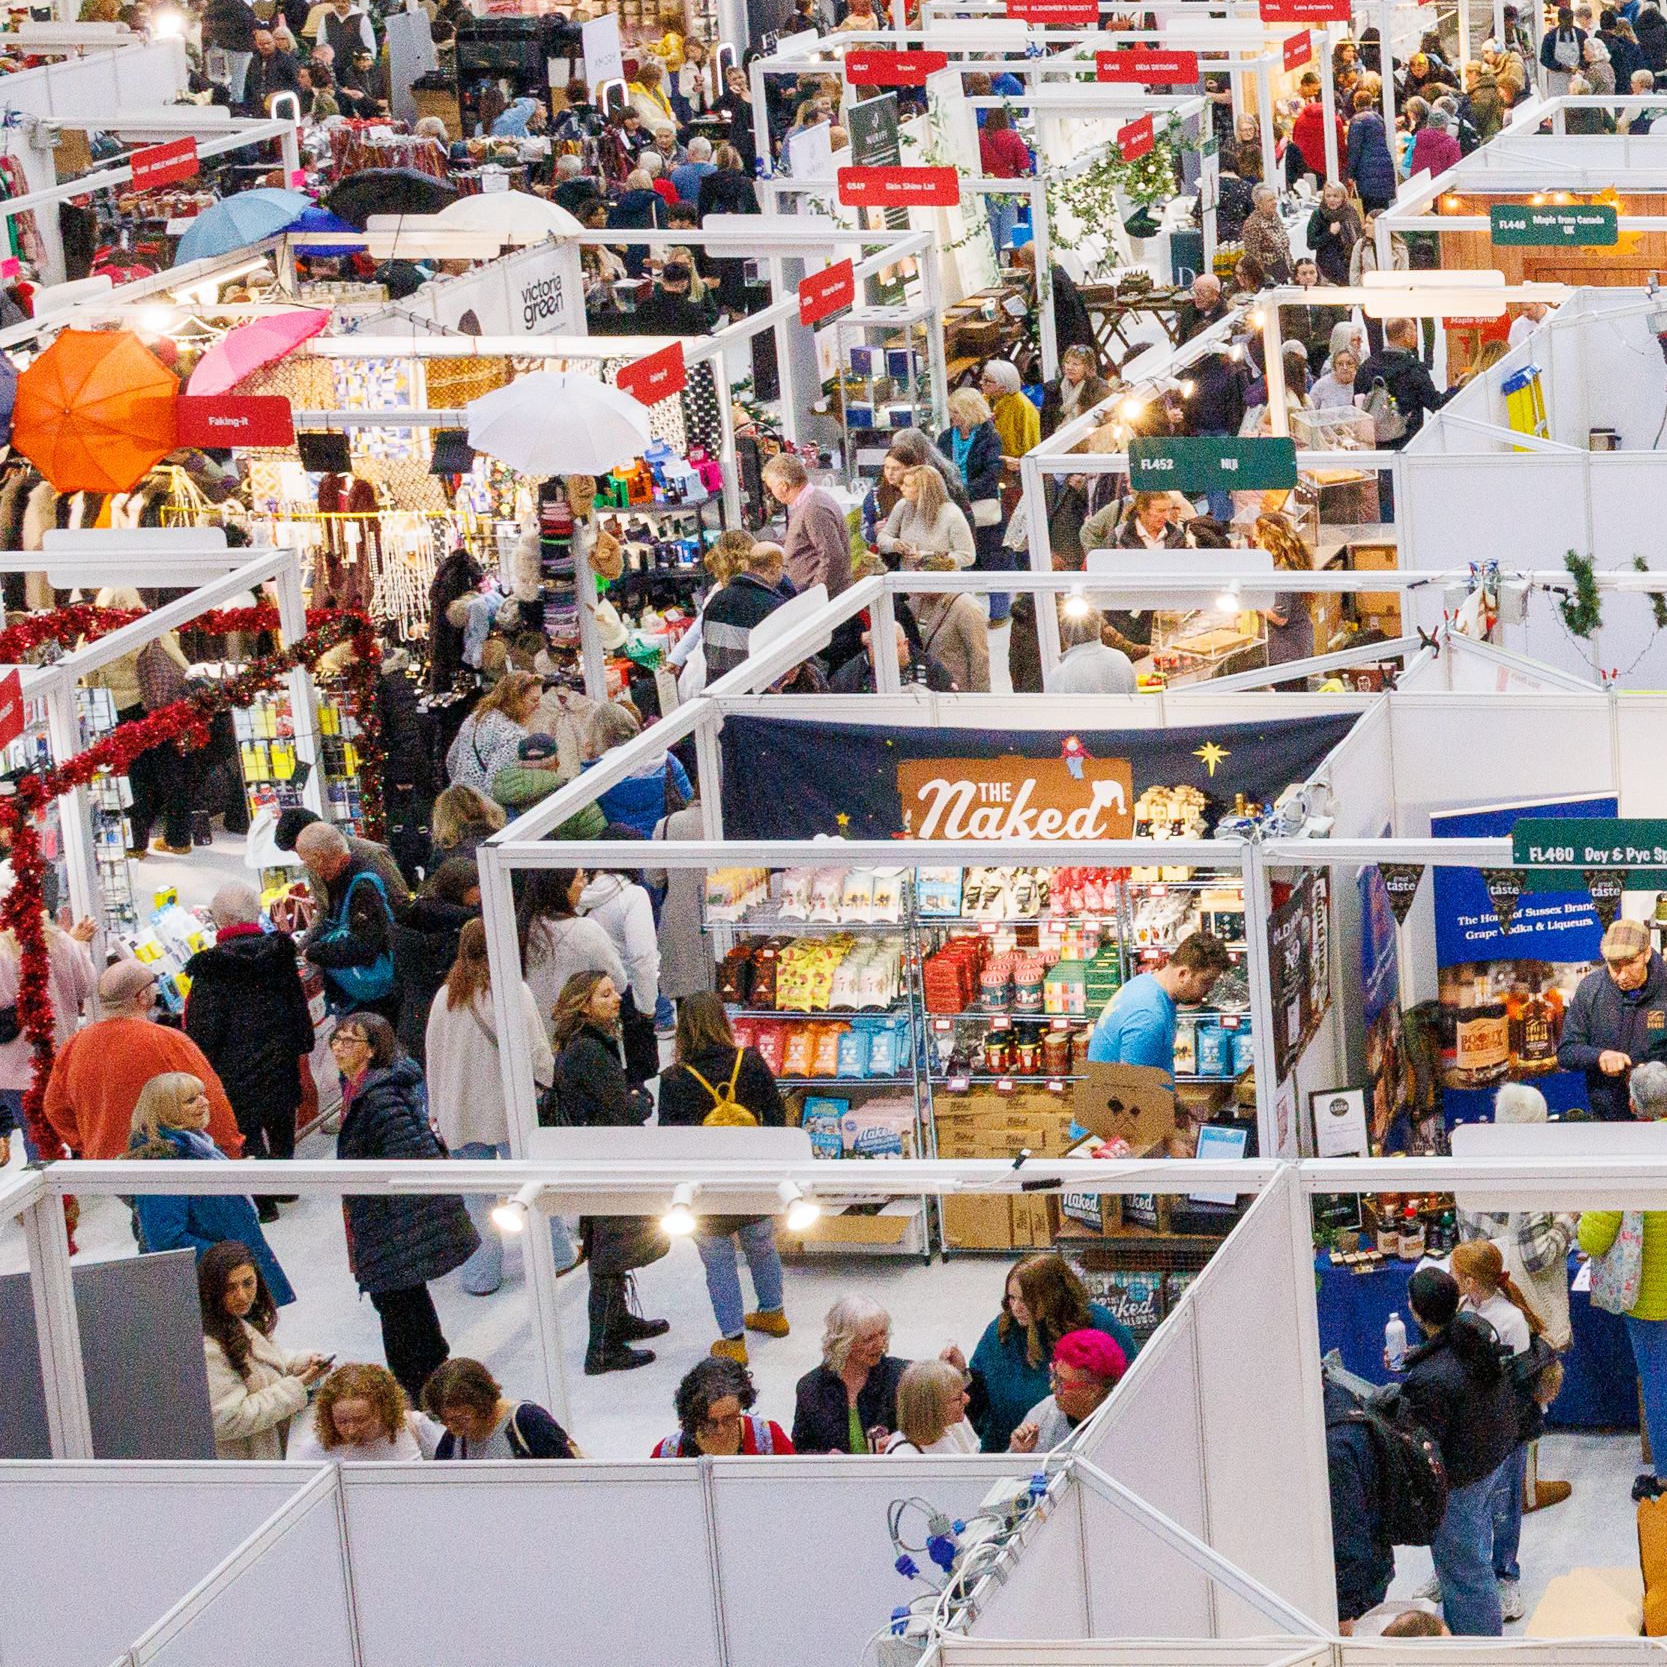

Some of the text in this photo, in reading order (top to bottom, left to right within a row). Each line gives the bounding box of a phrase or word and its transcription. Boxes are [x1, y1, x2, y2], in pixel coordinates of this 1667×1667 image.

[1030, 4, 1092, 12] ALZHEIMER'S SOCIETY
[923, 182, 935, 191] Ltd
[1533, 214, 1604, 225] Maple from Canada
[1563, 227, 1574, 235] UK
[521, 272, 563, 304] victoria
[522, 292, 566, 330] green
[208, 416, 248, 428] Faking-it
[1141, 458, 1173, 470] FL452
[978, 782, 1012, 803] THE
[1530, 846, 1574, 862] FL460
[1585, 846, 1609, 864] Dey
[1612, 847, 1623, 861] &
[1457, 907, 1556, 926] The of Sussex
[1465, 929, 1498, 943] Grape
[1502, 924, 1531, 938] odka
